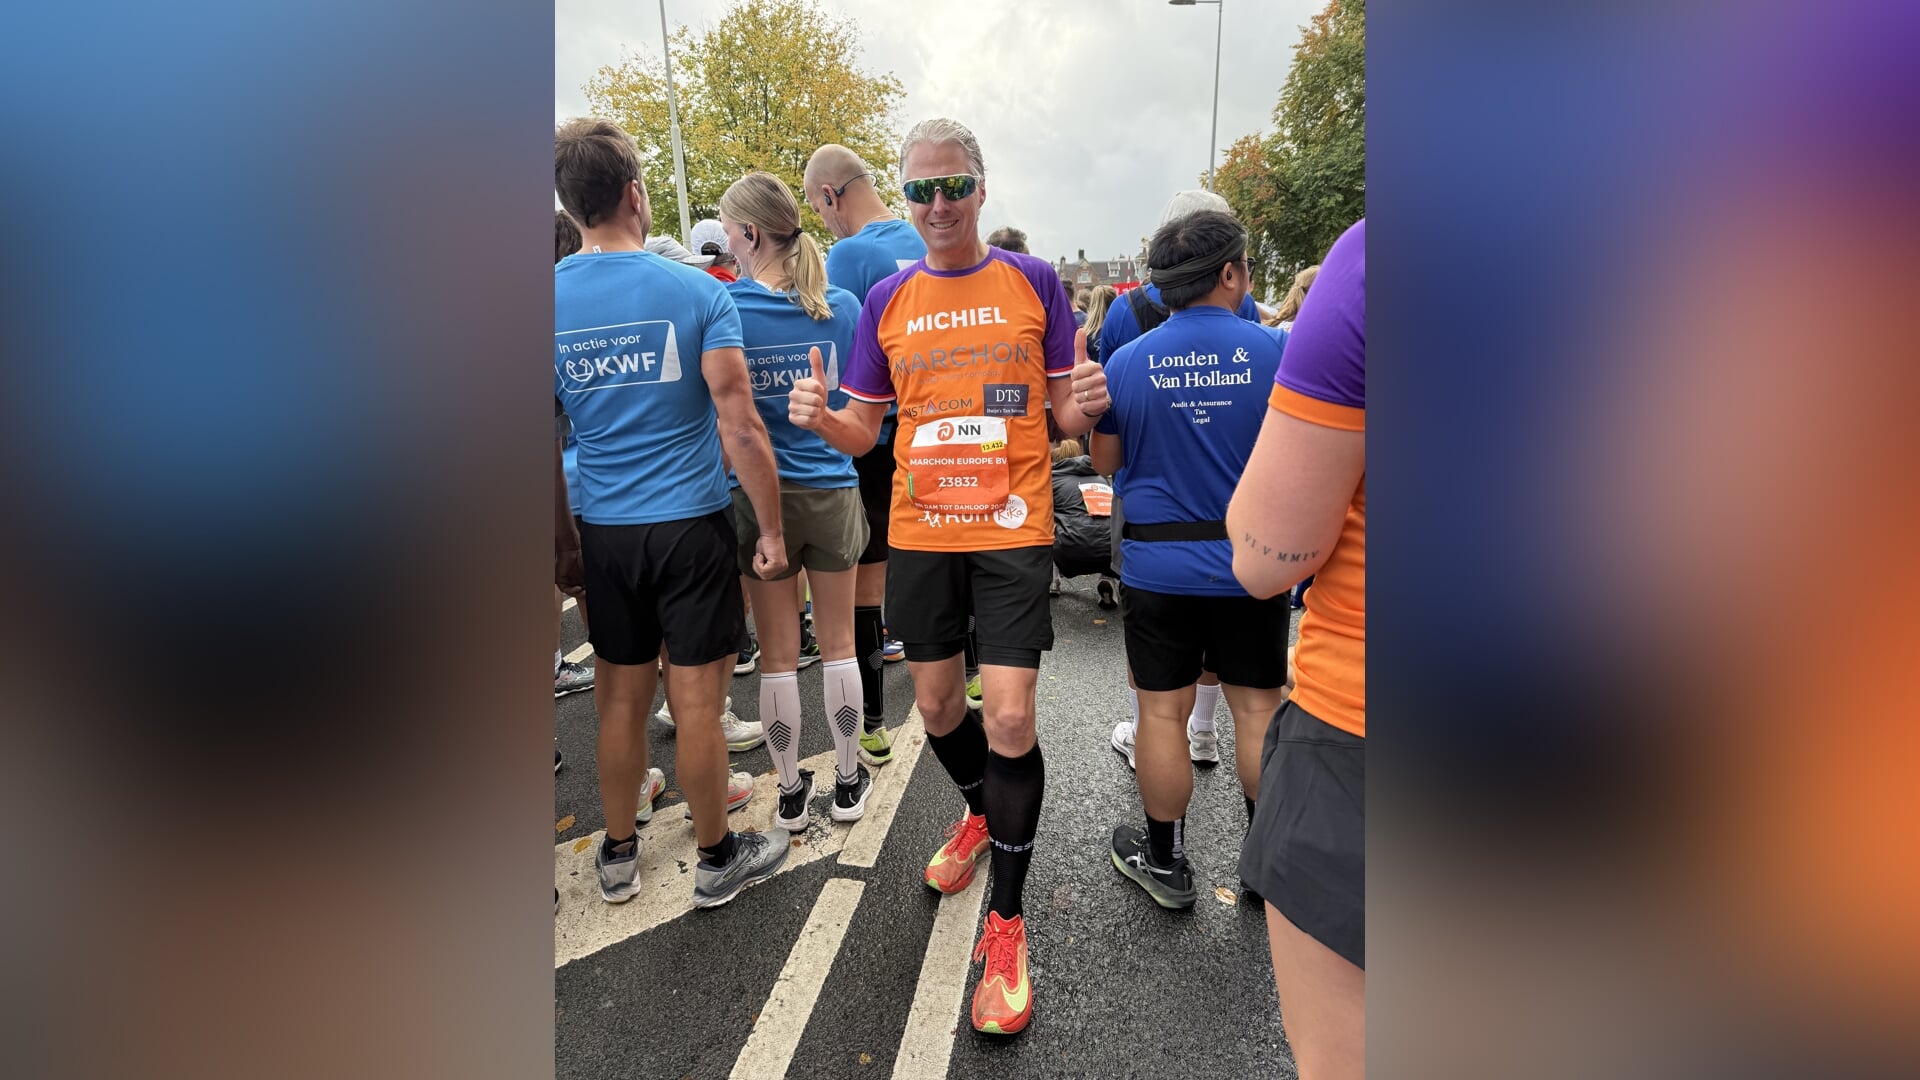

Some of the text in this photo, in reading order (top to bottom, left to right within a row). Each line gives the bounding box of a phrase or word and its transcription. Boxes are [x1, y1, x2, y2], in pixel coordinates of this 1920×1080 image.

[906, 306, 1008, 336] MICHIEL
[558, 334, 641, 354] In actie voor
[594, 351, 657, 377] KWF
[757, 353, 785, 365] actie
[895, 342, 1030, 379] MARCHON
[1147, 347, 1250, 370] Londen &
[772, 367, 814, 388] KW
[1149, 367, 1252, 390] Van Holland
[995, 389, 1021, 403] DTS
[1170, 399, 1233, 409] Audit & Assurance
[1194, 408, 1207, 416] Tax
[1192, 416, 1211, 425] Legal
[958, 424, 982, 436] NN
[909, 456, 1008, 466] MARCHON EUROPE BV
[938, 476, 979, 488] 23832
[940, 503, 953, 511] TOT
